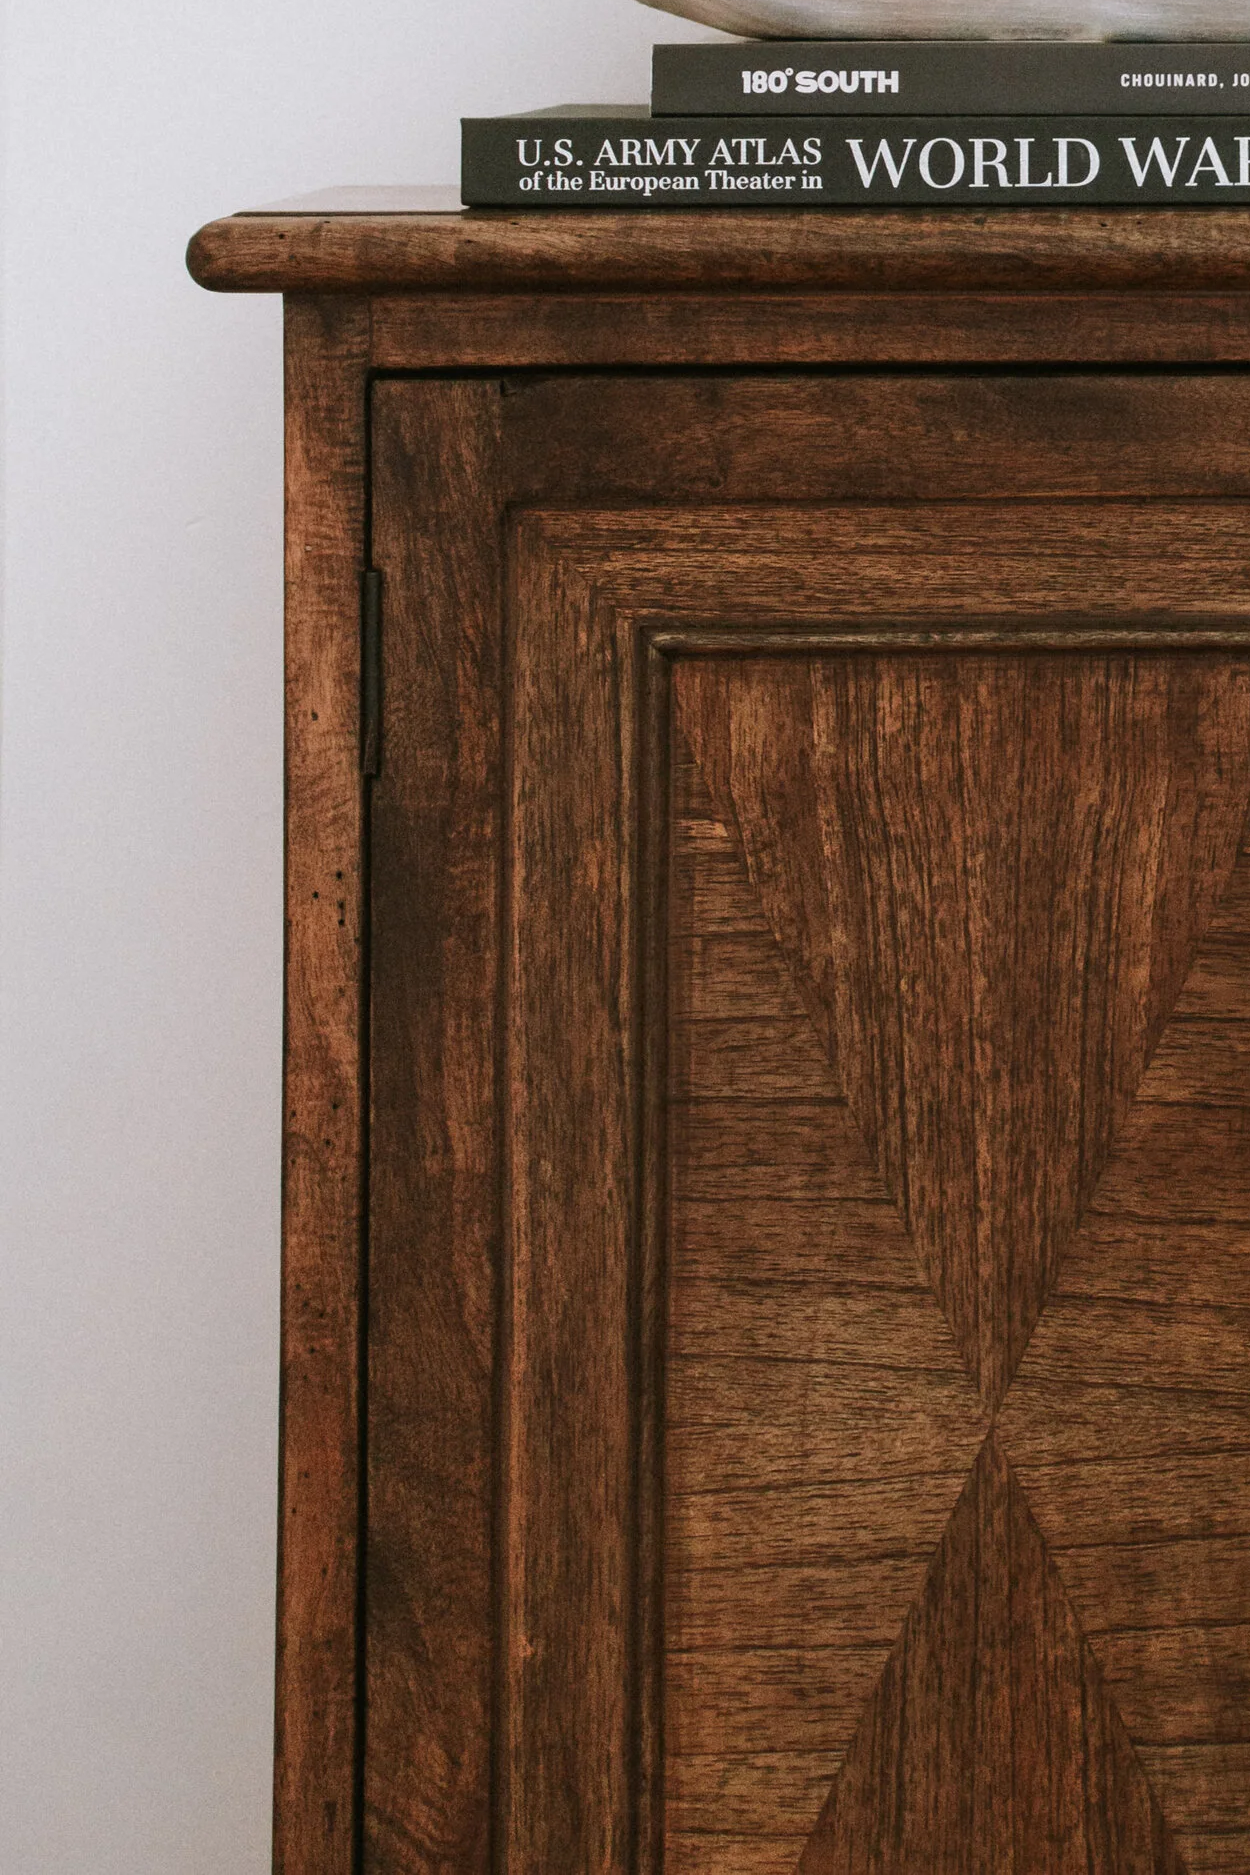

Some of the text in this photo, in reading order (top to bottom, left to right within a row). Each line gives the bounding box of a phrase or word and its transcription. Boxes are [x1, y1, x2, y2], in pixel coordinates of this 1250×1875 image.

[1120, 73, 1224, 89] CHOUINARD,
[516, 137, 823, 167] U.S. ARMY ATLAS
[845, 137, 1101, 189] WORLD
[518, 168, 824, 196] of the European Theater in
